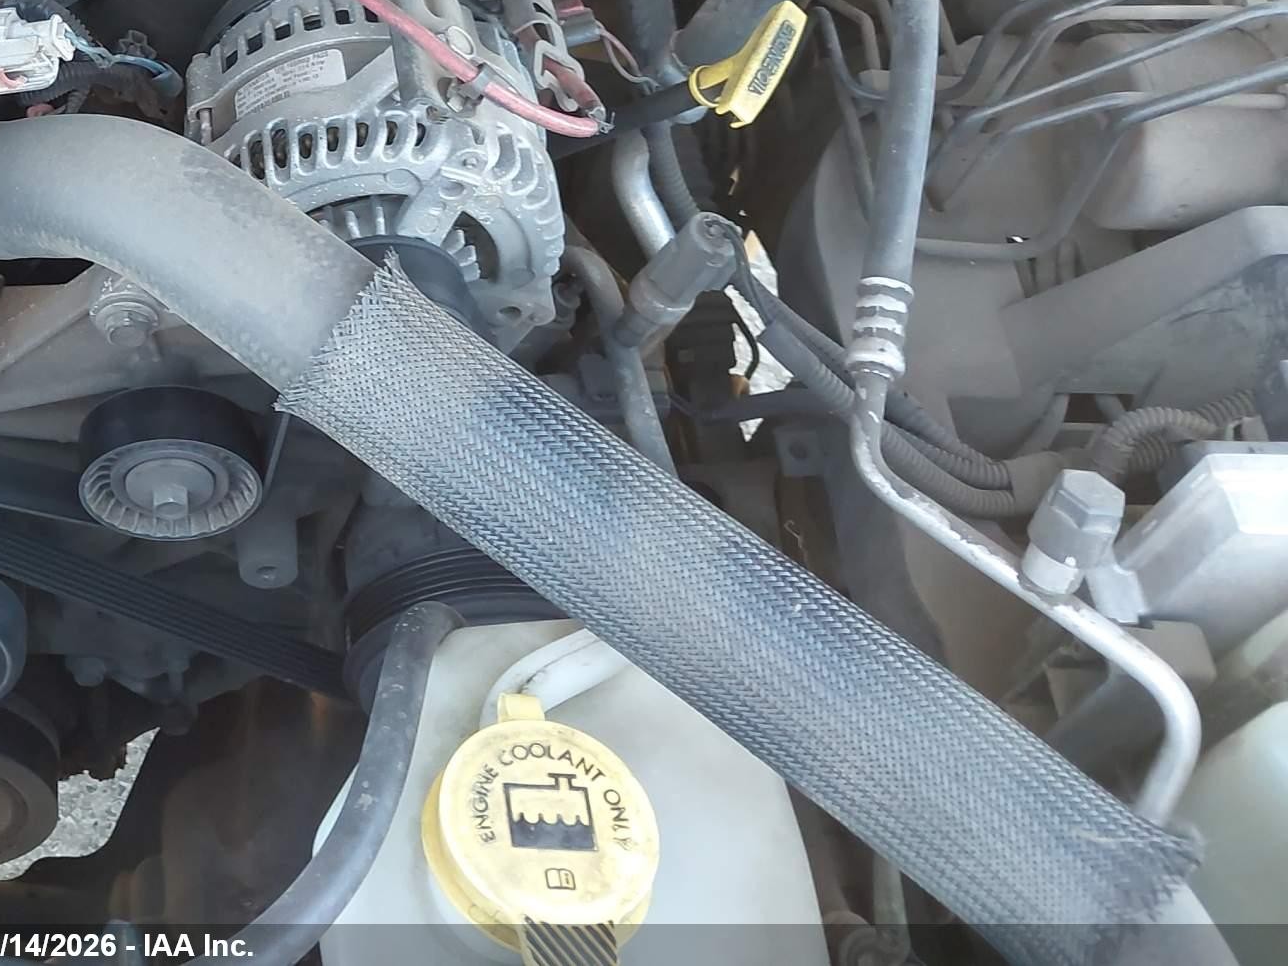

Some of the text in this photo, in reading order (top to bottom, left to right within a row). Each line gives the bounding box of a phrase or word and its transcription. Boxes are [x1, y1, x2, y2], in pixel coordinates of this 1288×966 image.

[469, 742, 631, 851] ENGINE COOLANT ONLY
